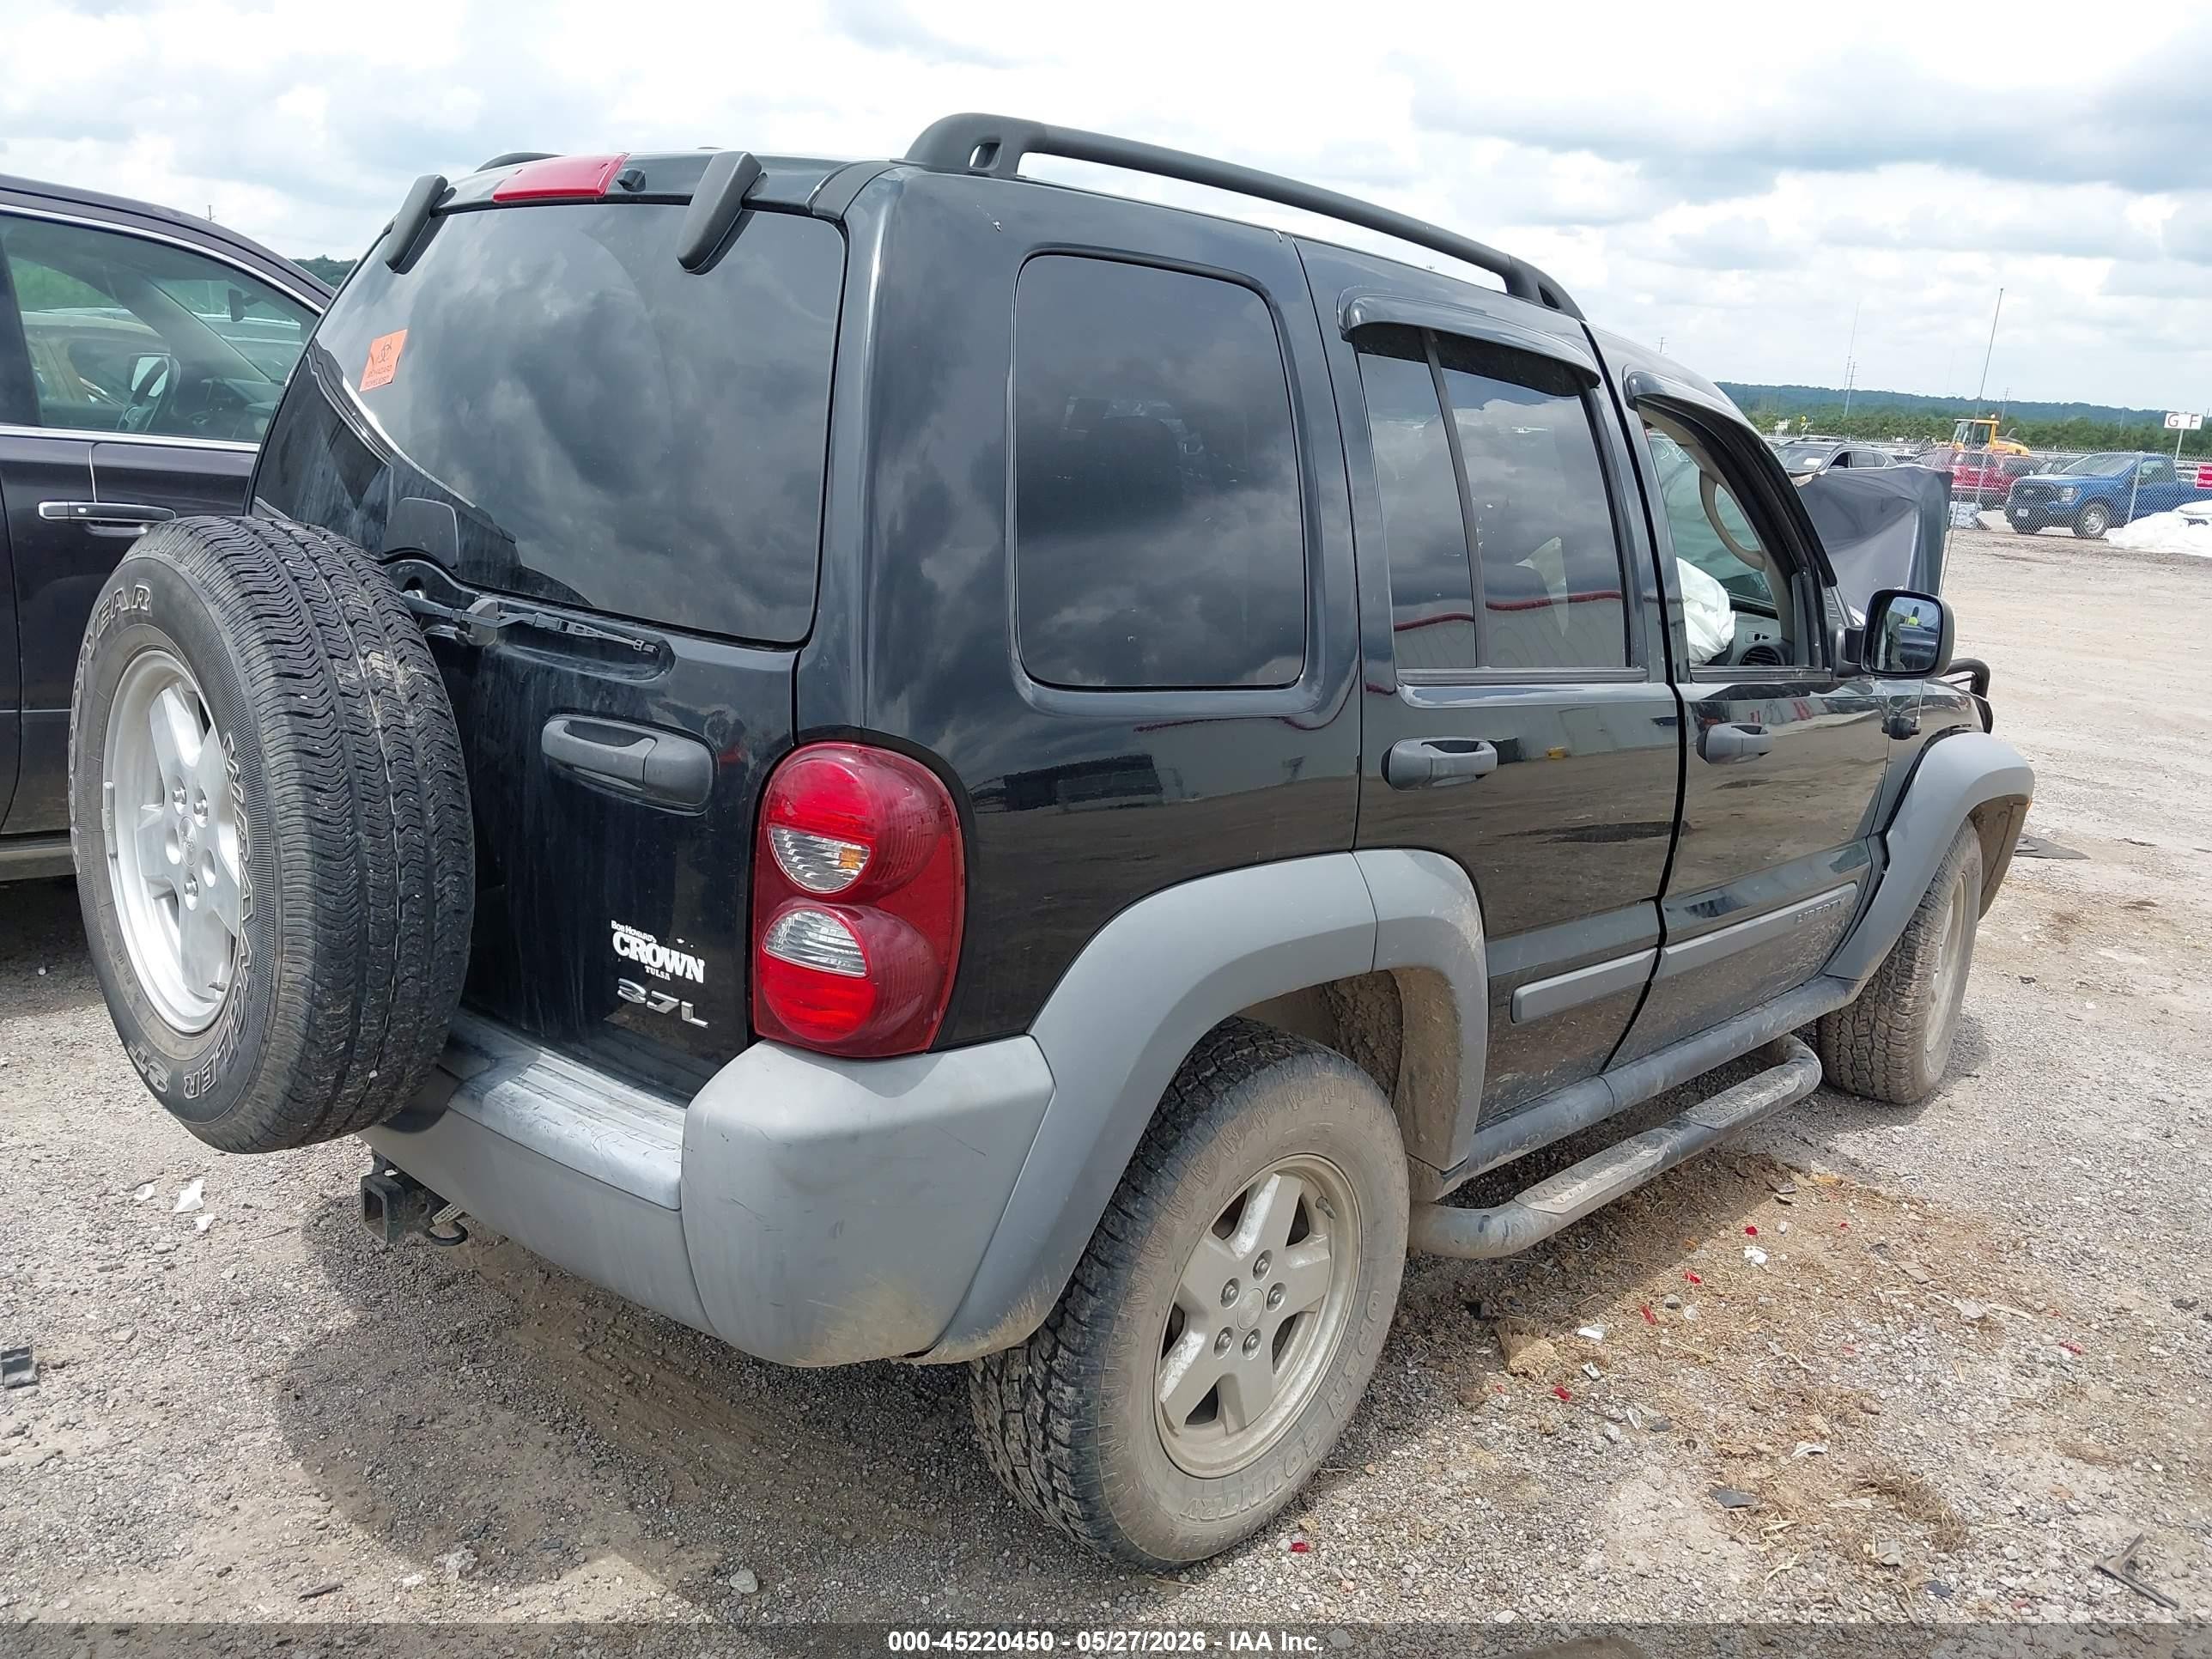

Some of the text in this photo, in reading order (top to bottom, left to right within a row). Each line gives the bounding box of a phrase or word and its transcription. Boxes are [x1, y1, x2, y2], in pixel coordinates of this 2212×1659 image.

[2167, 413, 2199, 428] G F
[183, 732, 255, 1101] WRANGLER
[612, 931, 706, 984] CROWN
[645, 965, 672, 981] TULSA
